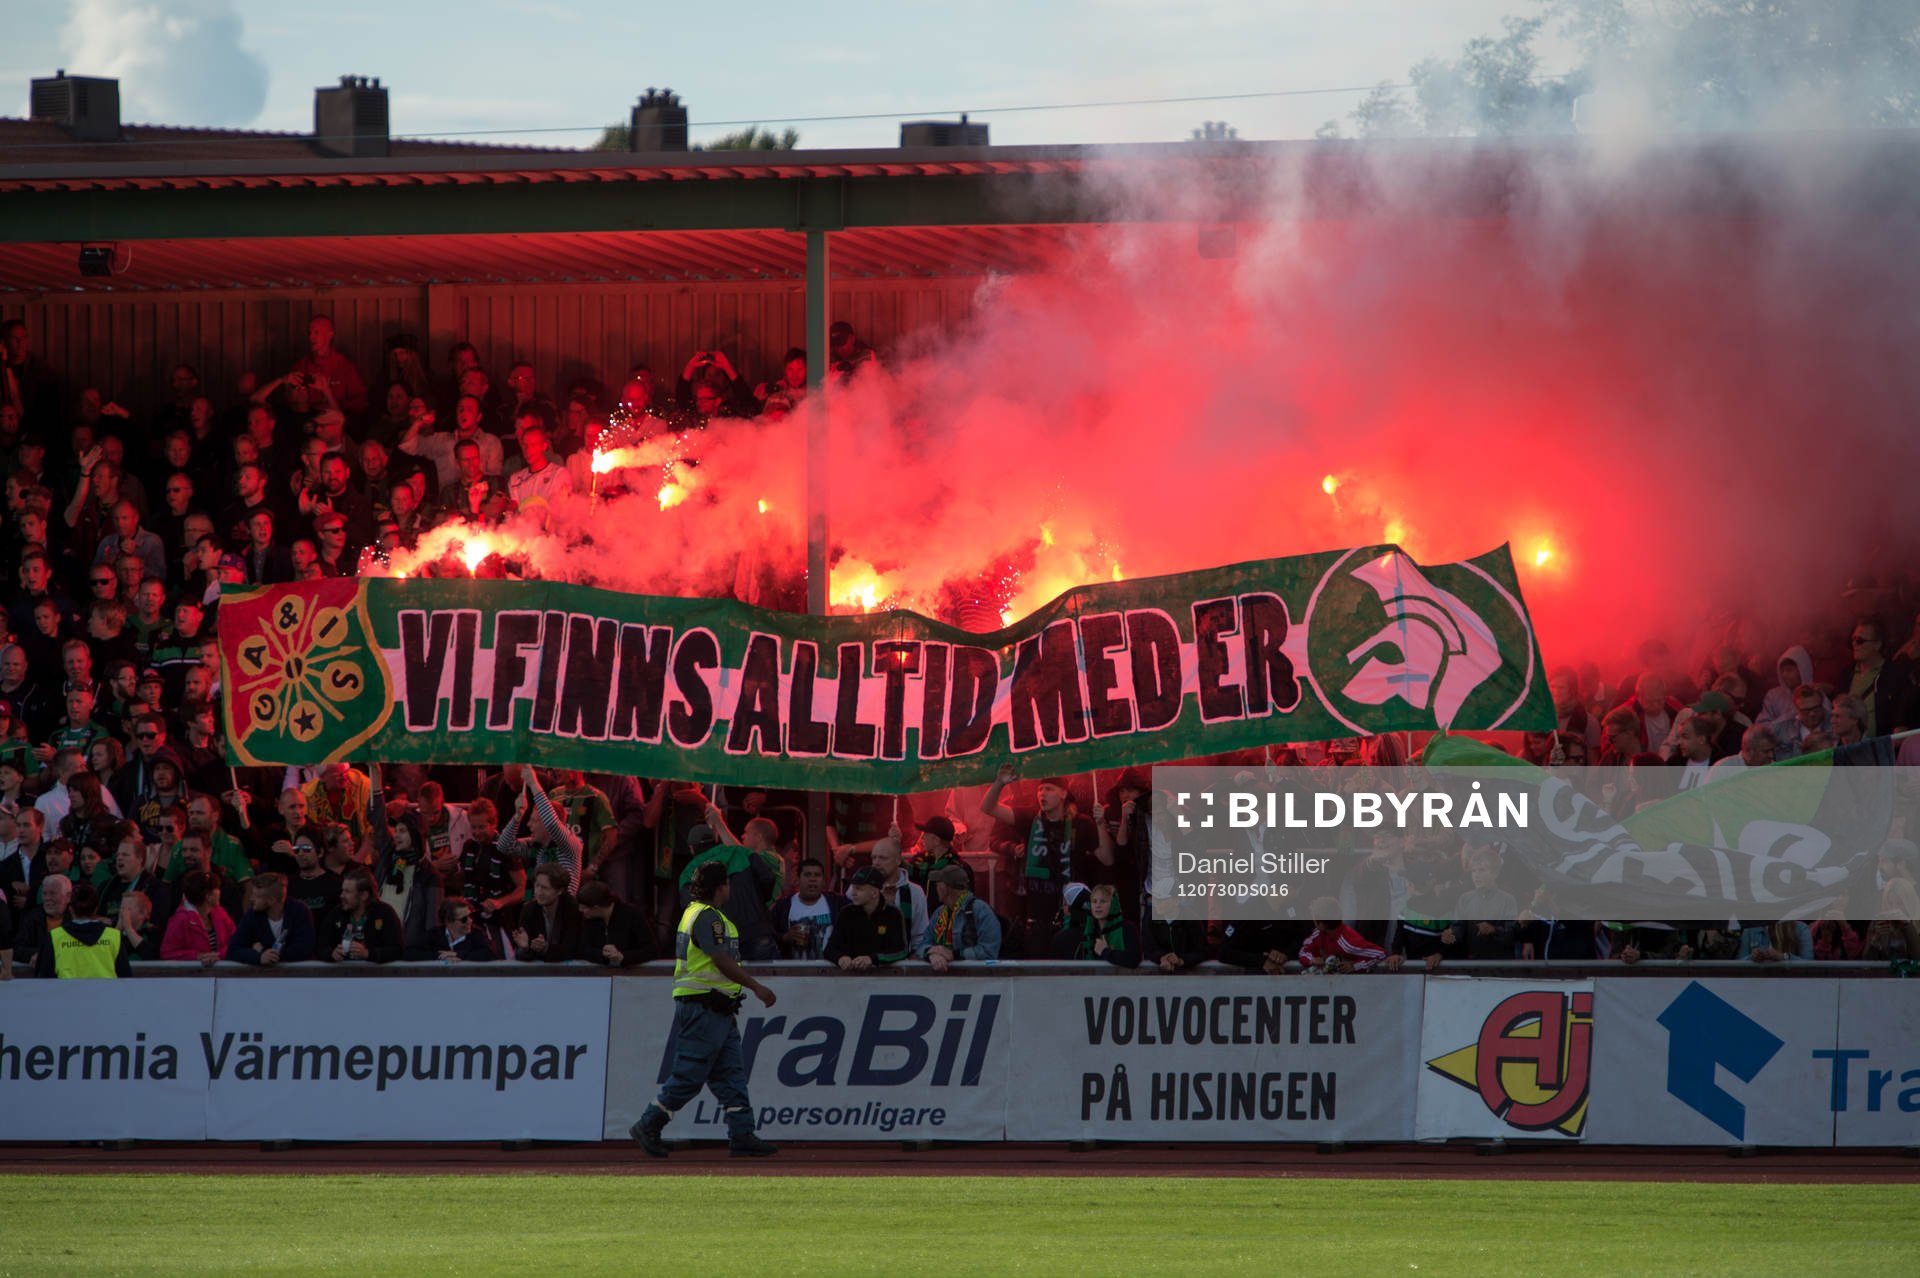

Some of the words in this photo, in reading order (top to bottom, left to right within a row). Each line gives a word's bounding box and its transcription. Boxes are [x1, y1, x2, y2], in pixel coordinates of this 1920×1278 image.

[398, 610, 482, 732] VI
[486, 610, 722, 750] FINNS
[724, 630, 1000, 761] ALLTID
[1010, 608, 1184, 753] MED
[1192, 592, 1302, 724] ER
[1084, 995, 1356, 1045] VOLVOCENTER
[200, 1031, 587, 1091] Värmepumpar
[757, 1102, 946, 1131] personligare
[1081, 1064, 1132, 1121] PÅ
[1150, 1072, 1336, 1121] HISINGEN
